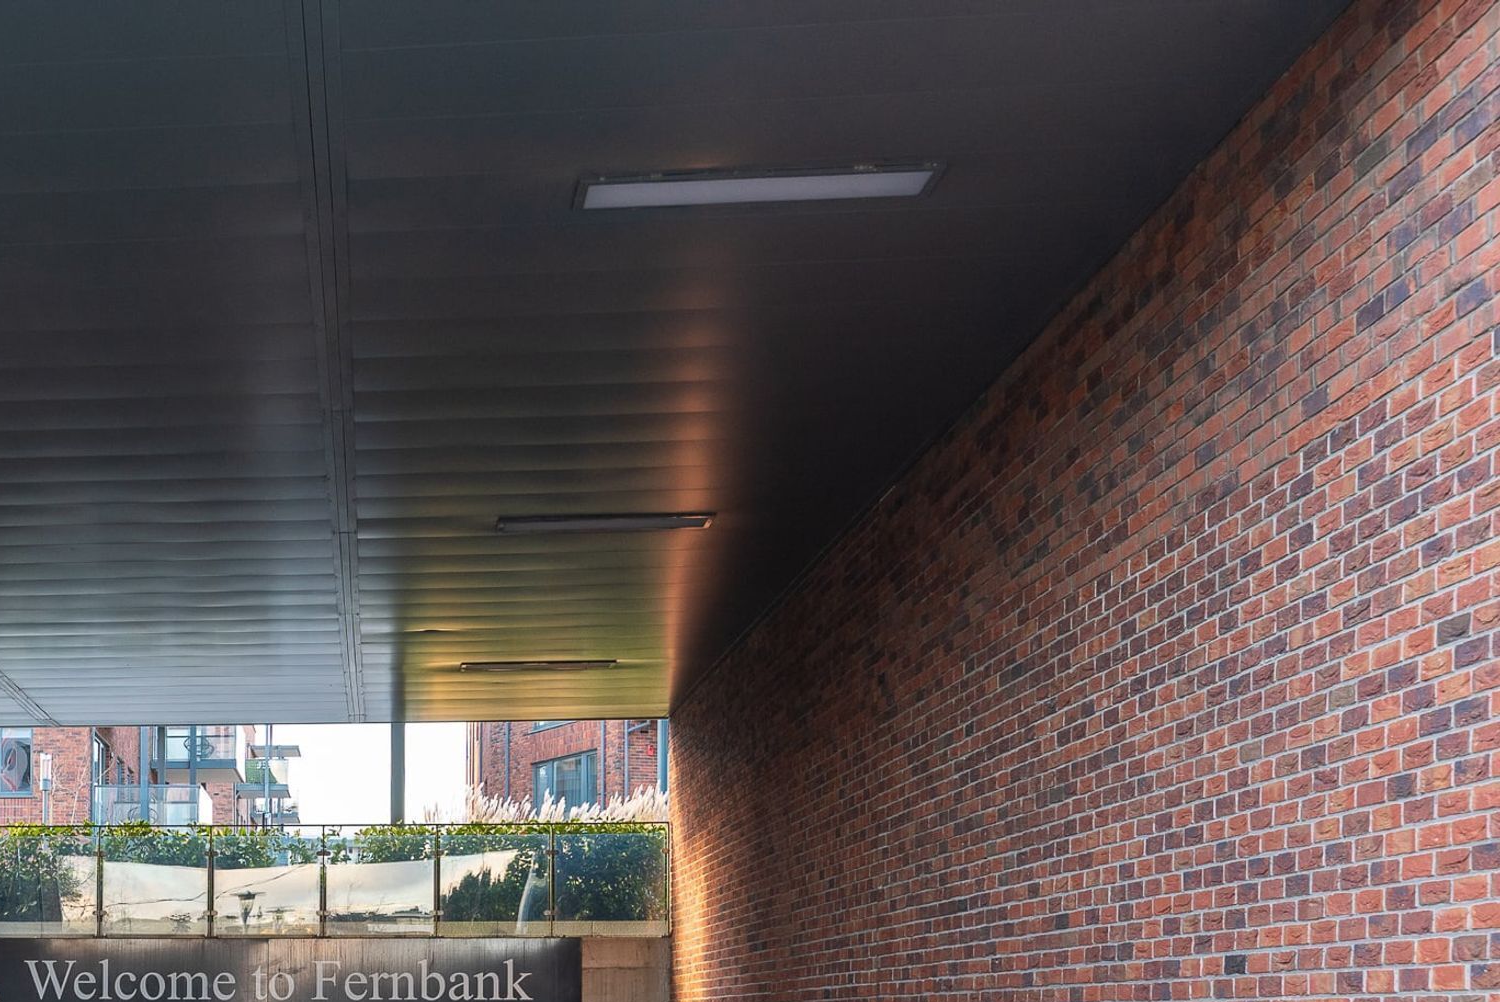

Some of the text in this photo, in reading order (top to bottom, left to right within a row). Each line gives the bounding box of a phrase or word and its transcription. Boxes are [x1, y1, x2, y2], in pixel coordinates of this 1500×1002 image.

[24, 958, 534, 1001] Welcome to Fernbank
